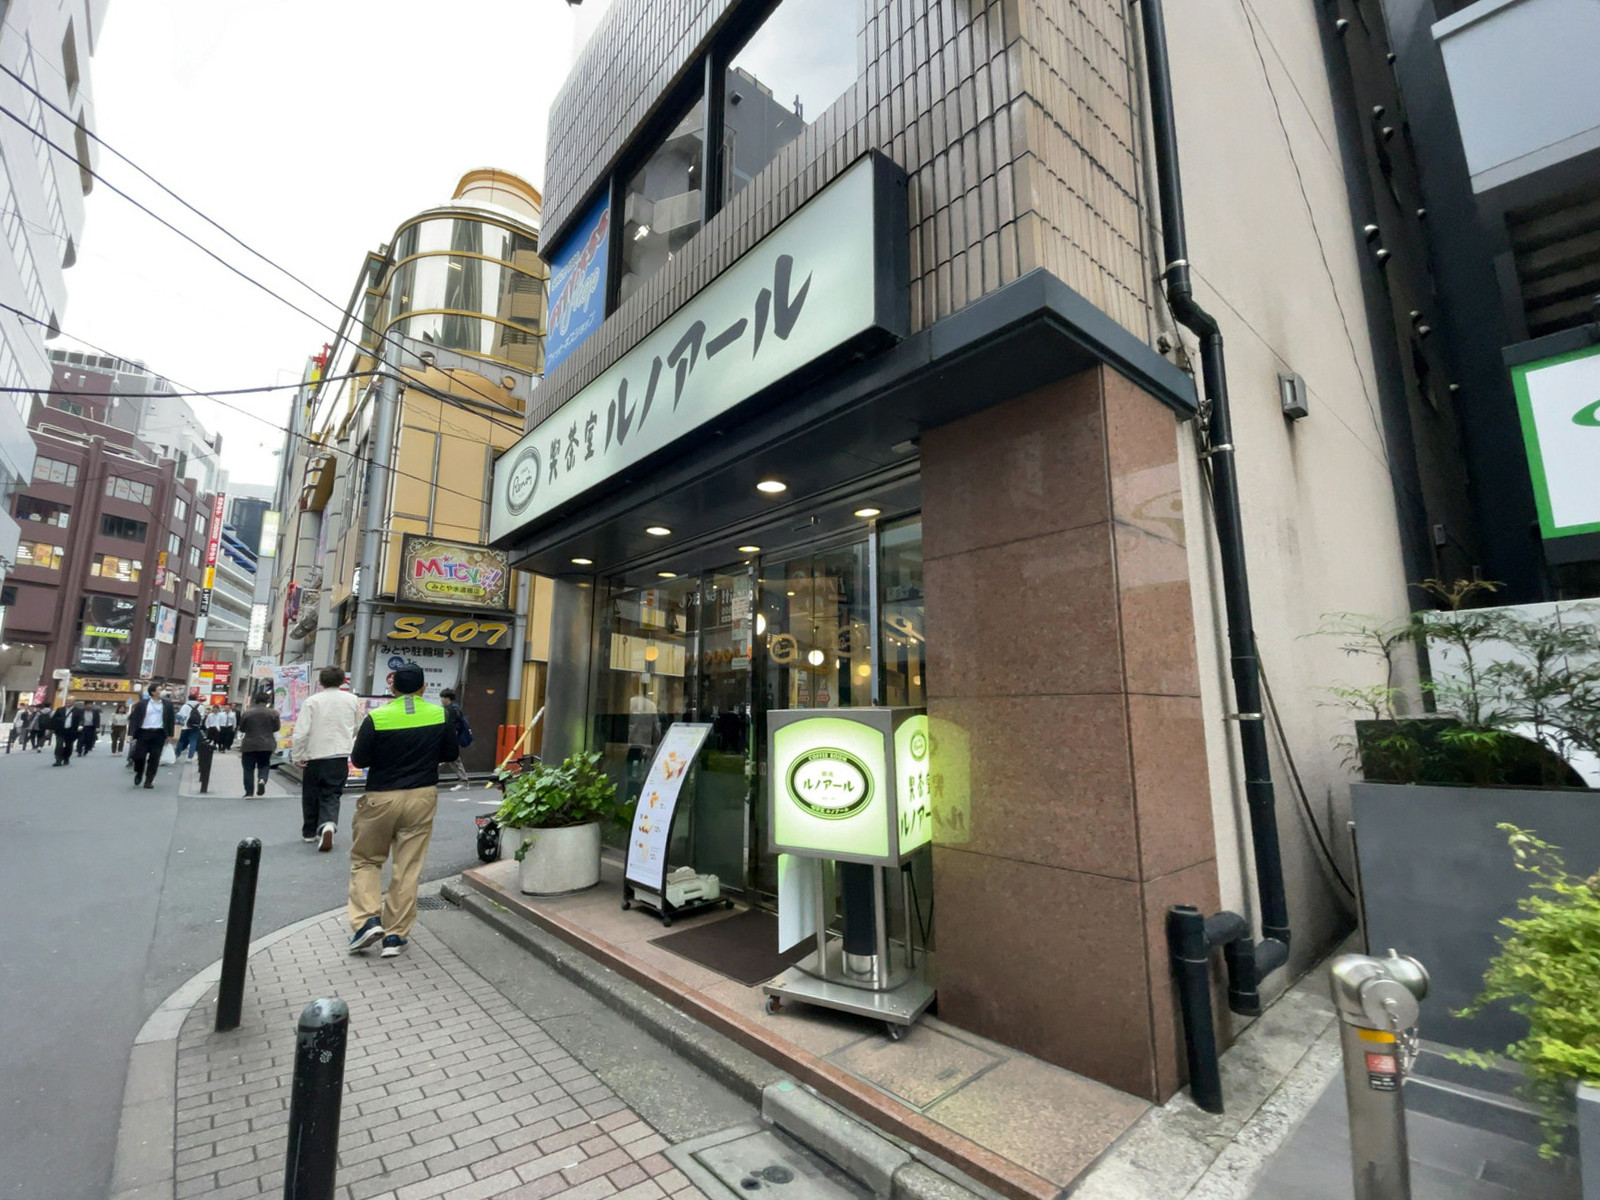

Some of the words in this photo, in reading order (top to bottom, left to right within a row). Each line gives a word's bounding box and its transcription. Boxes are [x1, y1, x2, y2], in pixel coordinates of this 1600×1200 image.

[387, 616, 508, 646] SLOT
[803, 778, 855, 792] ルノアール
